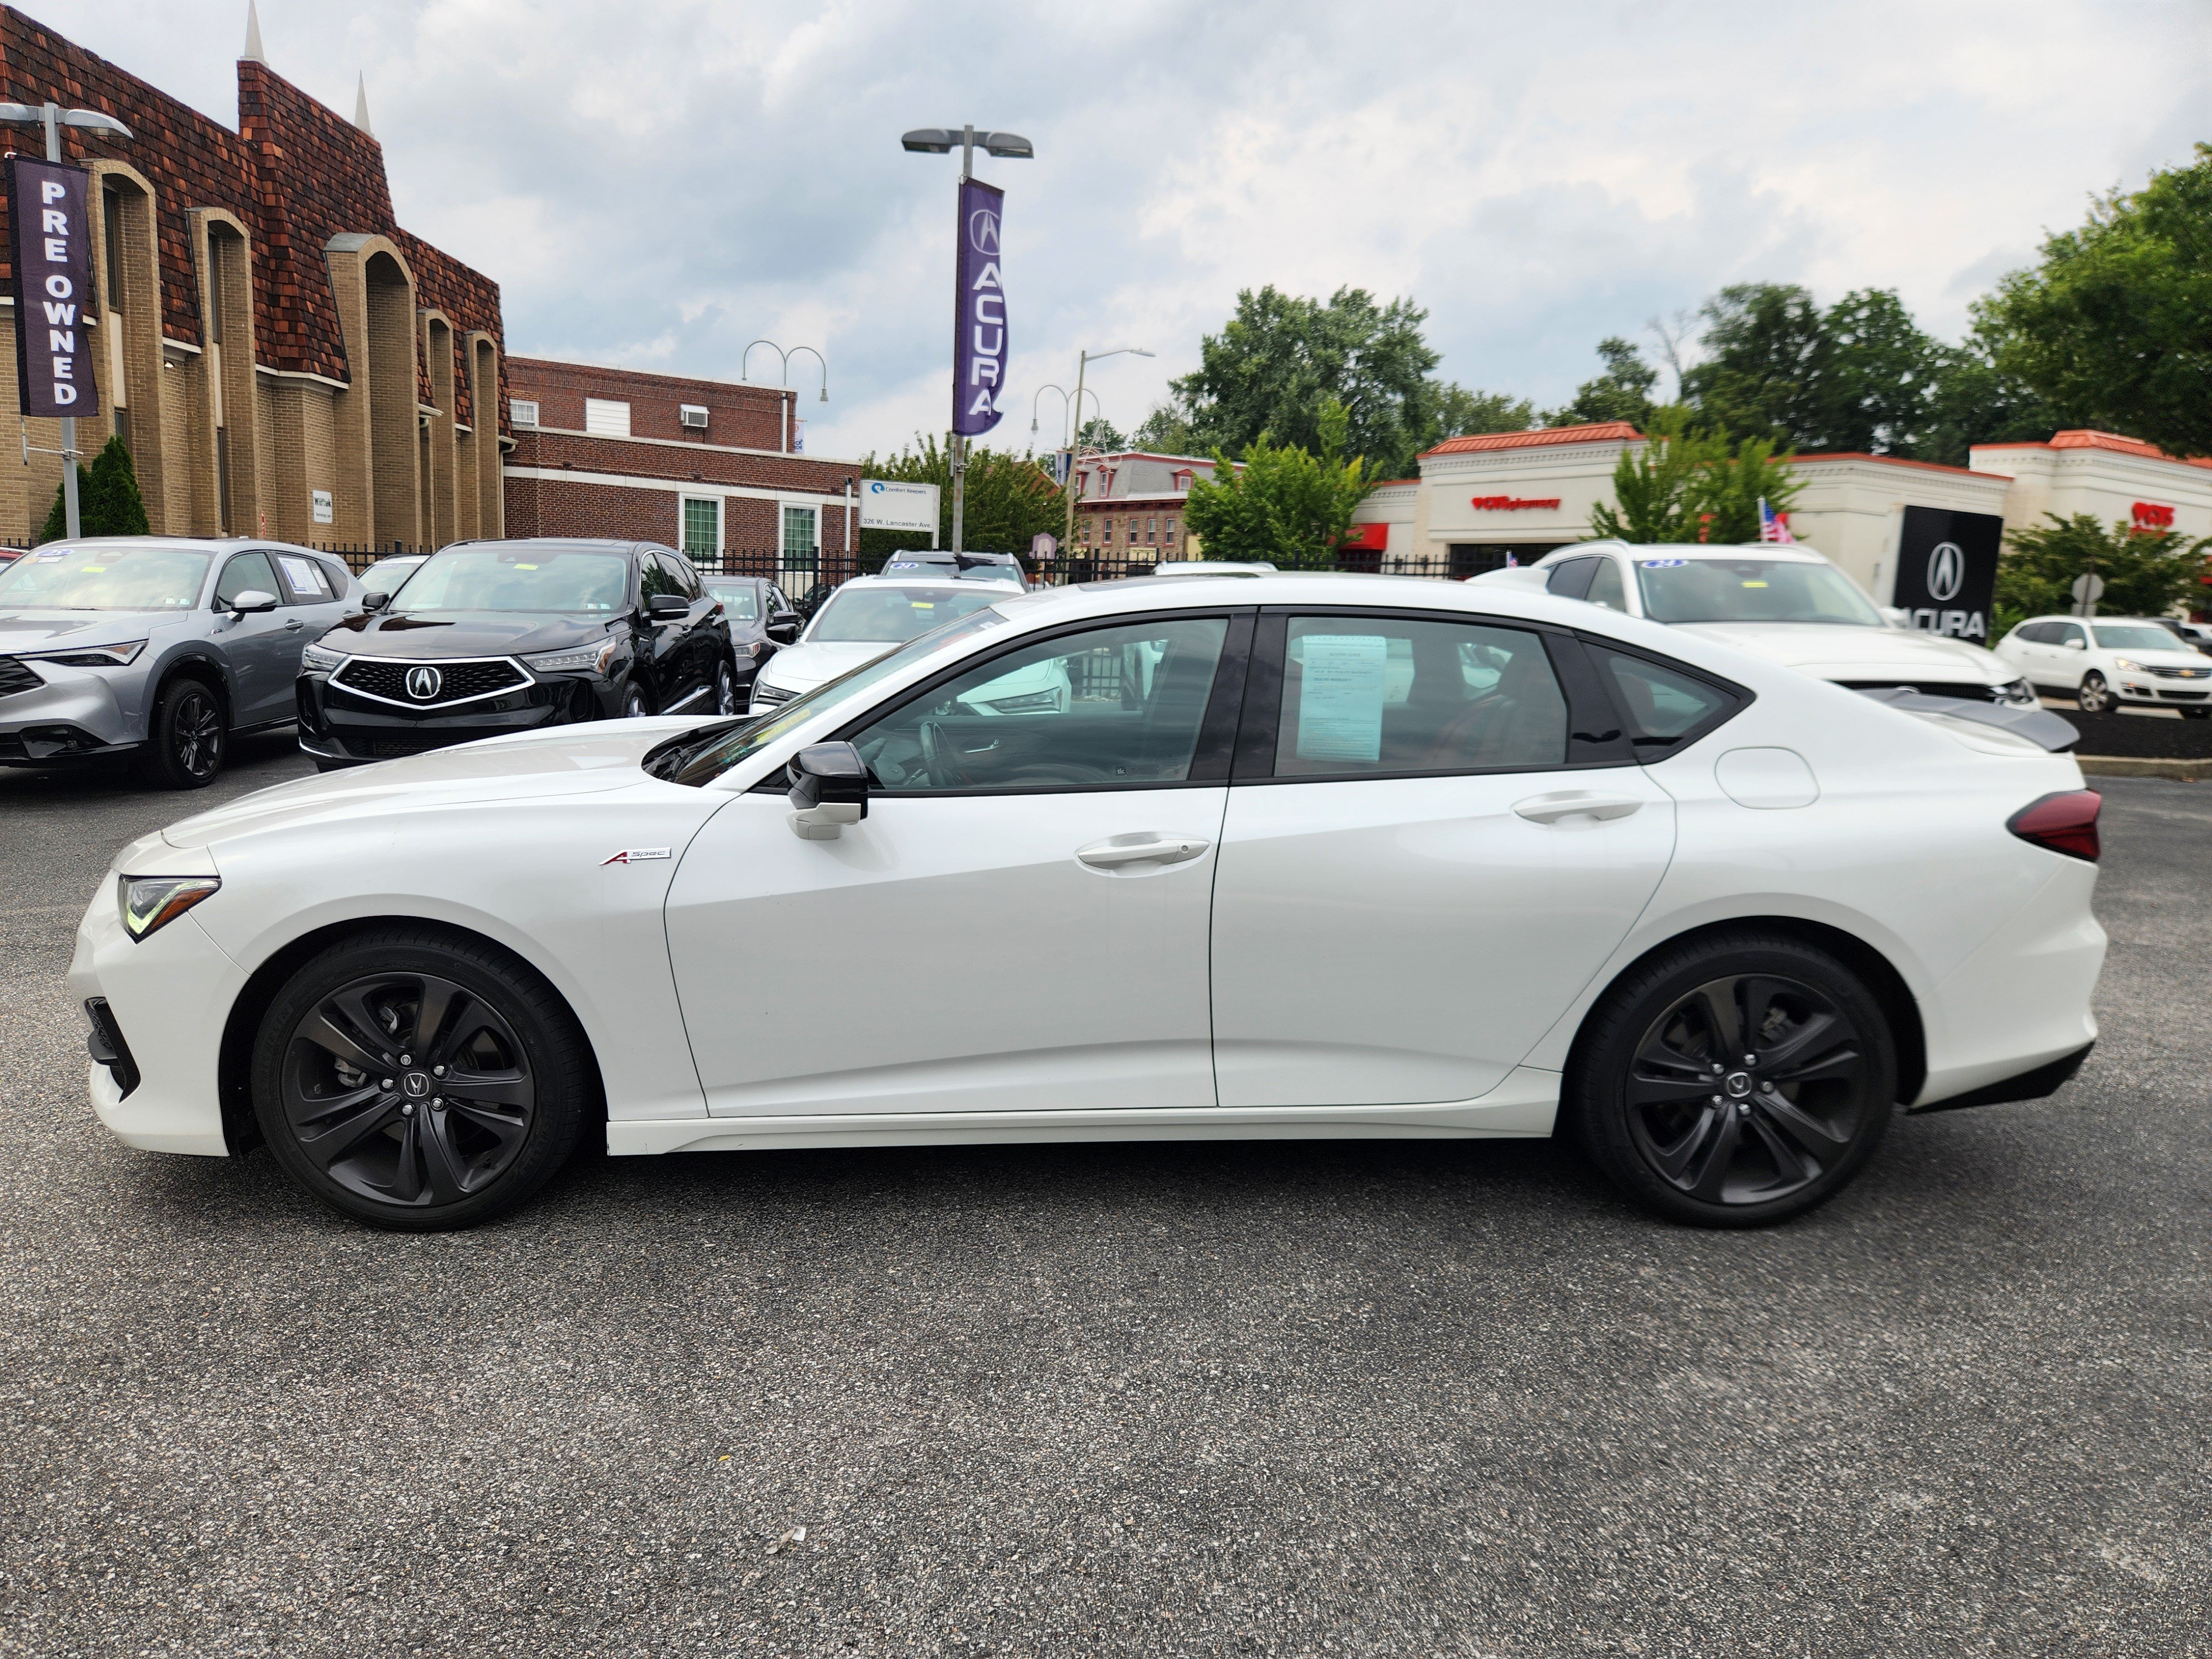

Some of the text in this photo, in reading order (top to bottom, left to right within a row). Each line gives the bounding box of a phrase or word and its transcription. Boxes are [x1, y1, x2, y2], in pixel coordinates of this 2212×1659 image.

[42, 180, 77, 405] PRE OWNED
[969, 262, 1004, 416] ACURA
